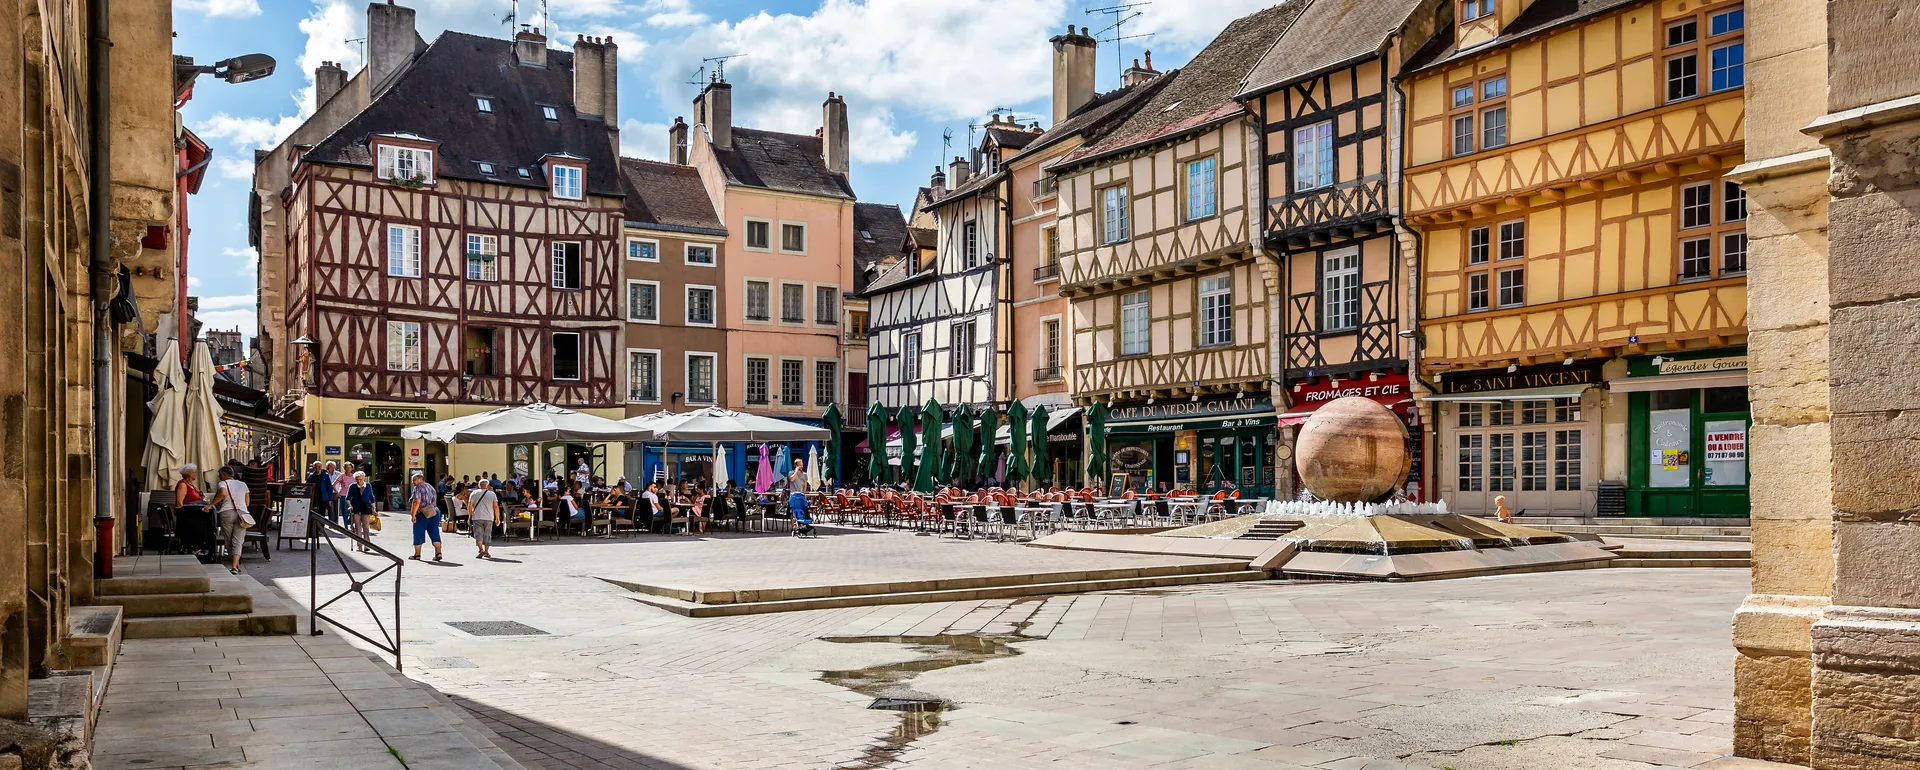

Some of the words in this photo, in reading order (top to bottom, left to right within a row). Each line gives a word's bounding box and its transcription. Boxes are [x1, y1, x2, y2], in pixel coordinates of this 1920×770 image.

[1660, 361, 1708, 374] Légendes
[1450, 381, 1467, 393] Le
[1473, 376, 1516, 391] SAINT
[1524, 369, 1591, 386] VINCENT
[1305, 388, 1361, 401] FROMAGES
[1364, 385, 1381, 396] ET
[1381, 384, 1400, 395] CIE
[1141, 406, 1158, 417] DU
[1162, 402, 1202, 415] VERRE
[1206, 398, 1256, 413] GALANT
[365, 410, 375, 418] LE
[377, 410, 429, 419] MAJORELLE
[1147, 423, 1184, 432] Restaurant
[1244, 418, 1261, 426] Vins
[1652, 420, 1688, 434] Gastronomie
[1667, 429, 1673, 437] &
[1714, 432, 1744, 441] VENDRE
[1655, 438, 1683, 447] Cadeaux
[1707, 443, 1717, 451] OU
[1718, 443, 1723, 451] A
[1724, 442, 1744, 450] LOUER
